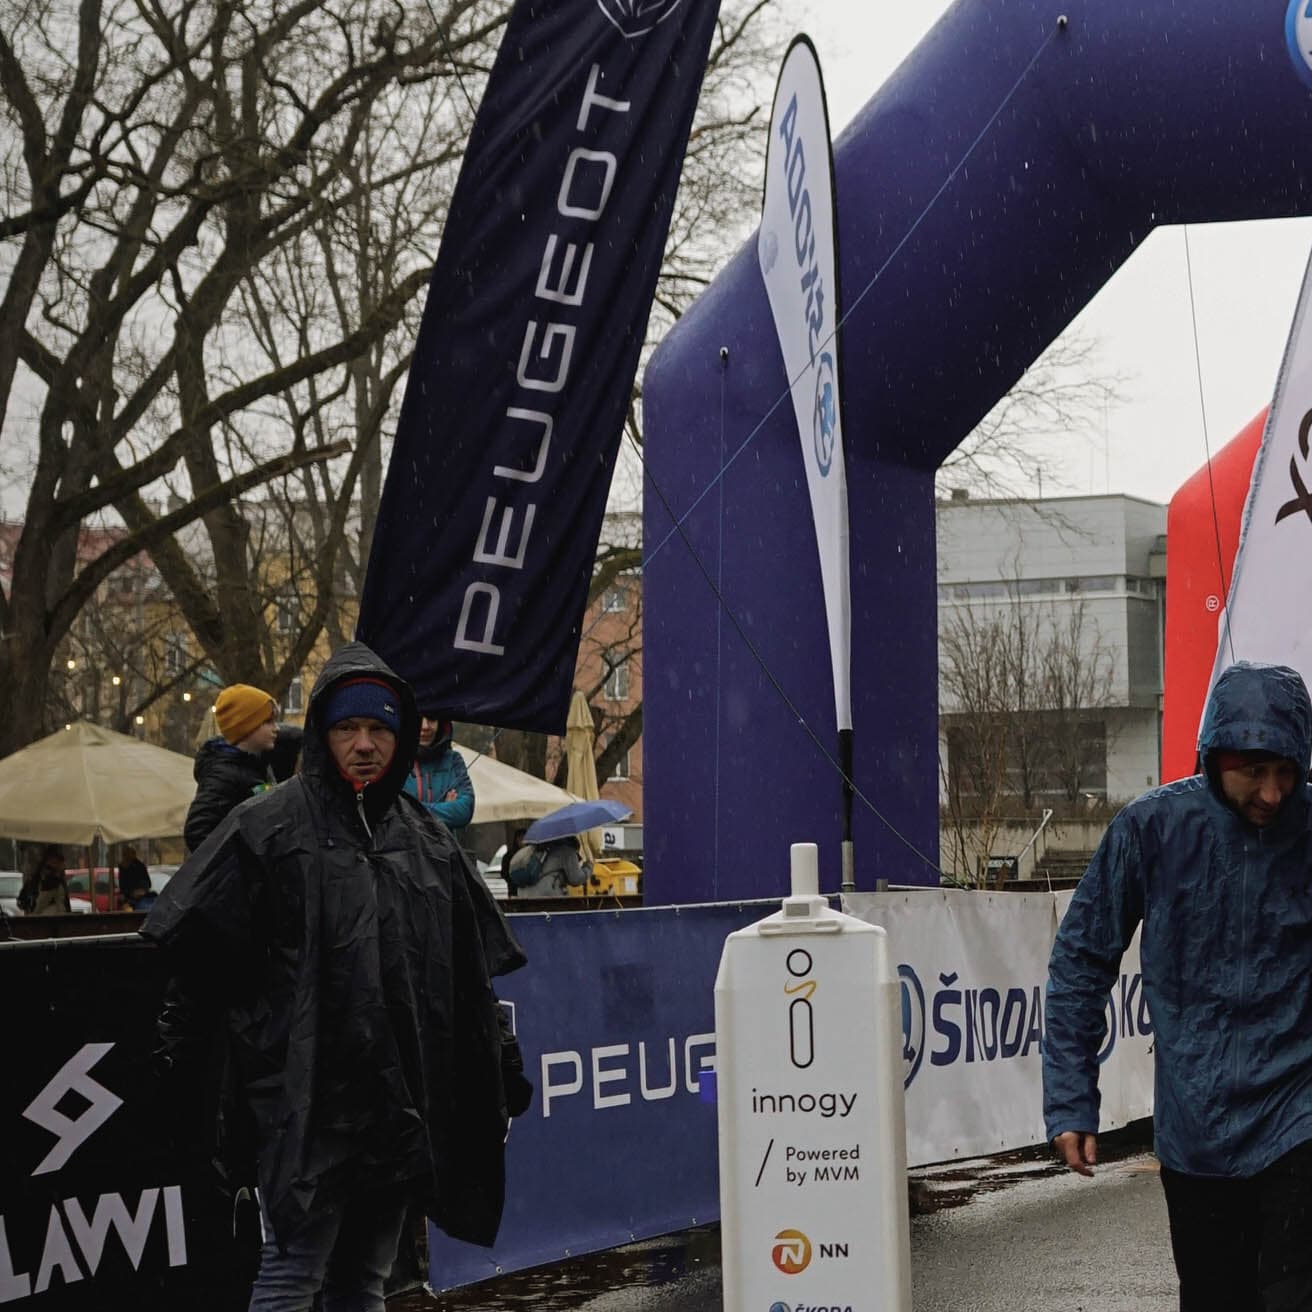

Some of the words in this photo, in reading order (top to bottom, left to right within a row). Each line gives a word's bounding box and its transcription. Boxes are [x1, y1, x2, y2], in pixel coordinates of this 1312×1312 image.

[453, 63, 631, 656] PEUGEOT
[930, 972, 1044, 1066] ŠKODA
[541, 1032, 717, 1118] PEUG
[752, 1088, 857, 1118] innogy
[786, 1144, 860, 1161] Powered
[786, 1168, 806, 1187] by
[814, 1166, 860, 1182] MVM
[819, 1243, 849, 1258] NN
